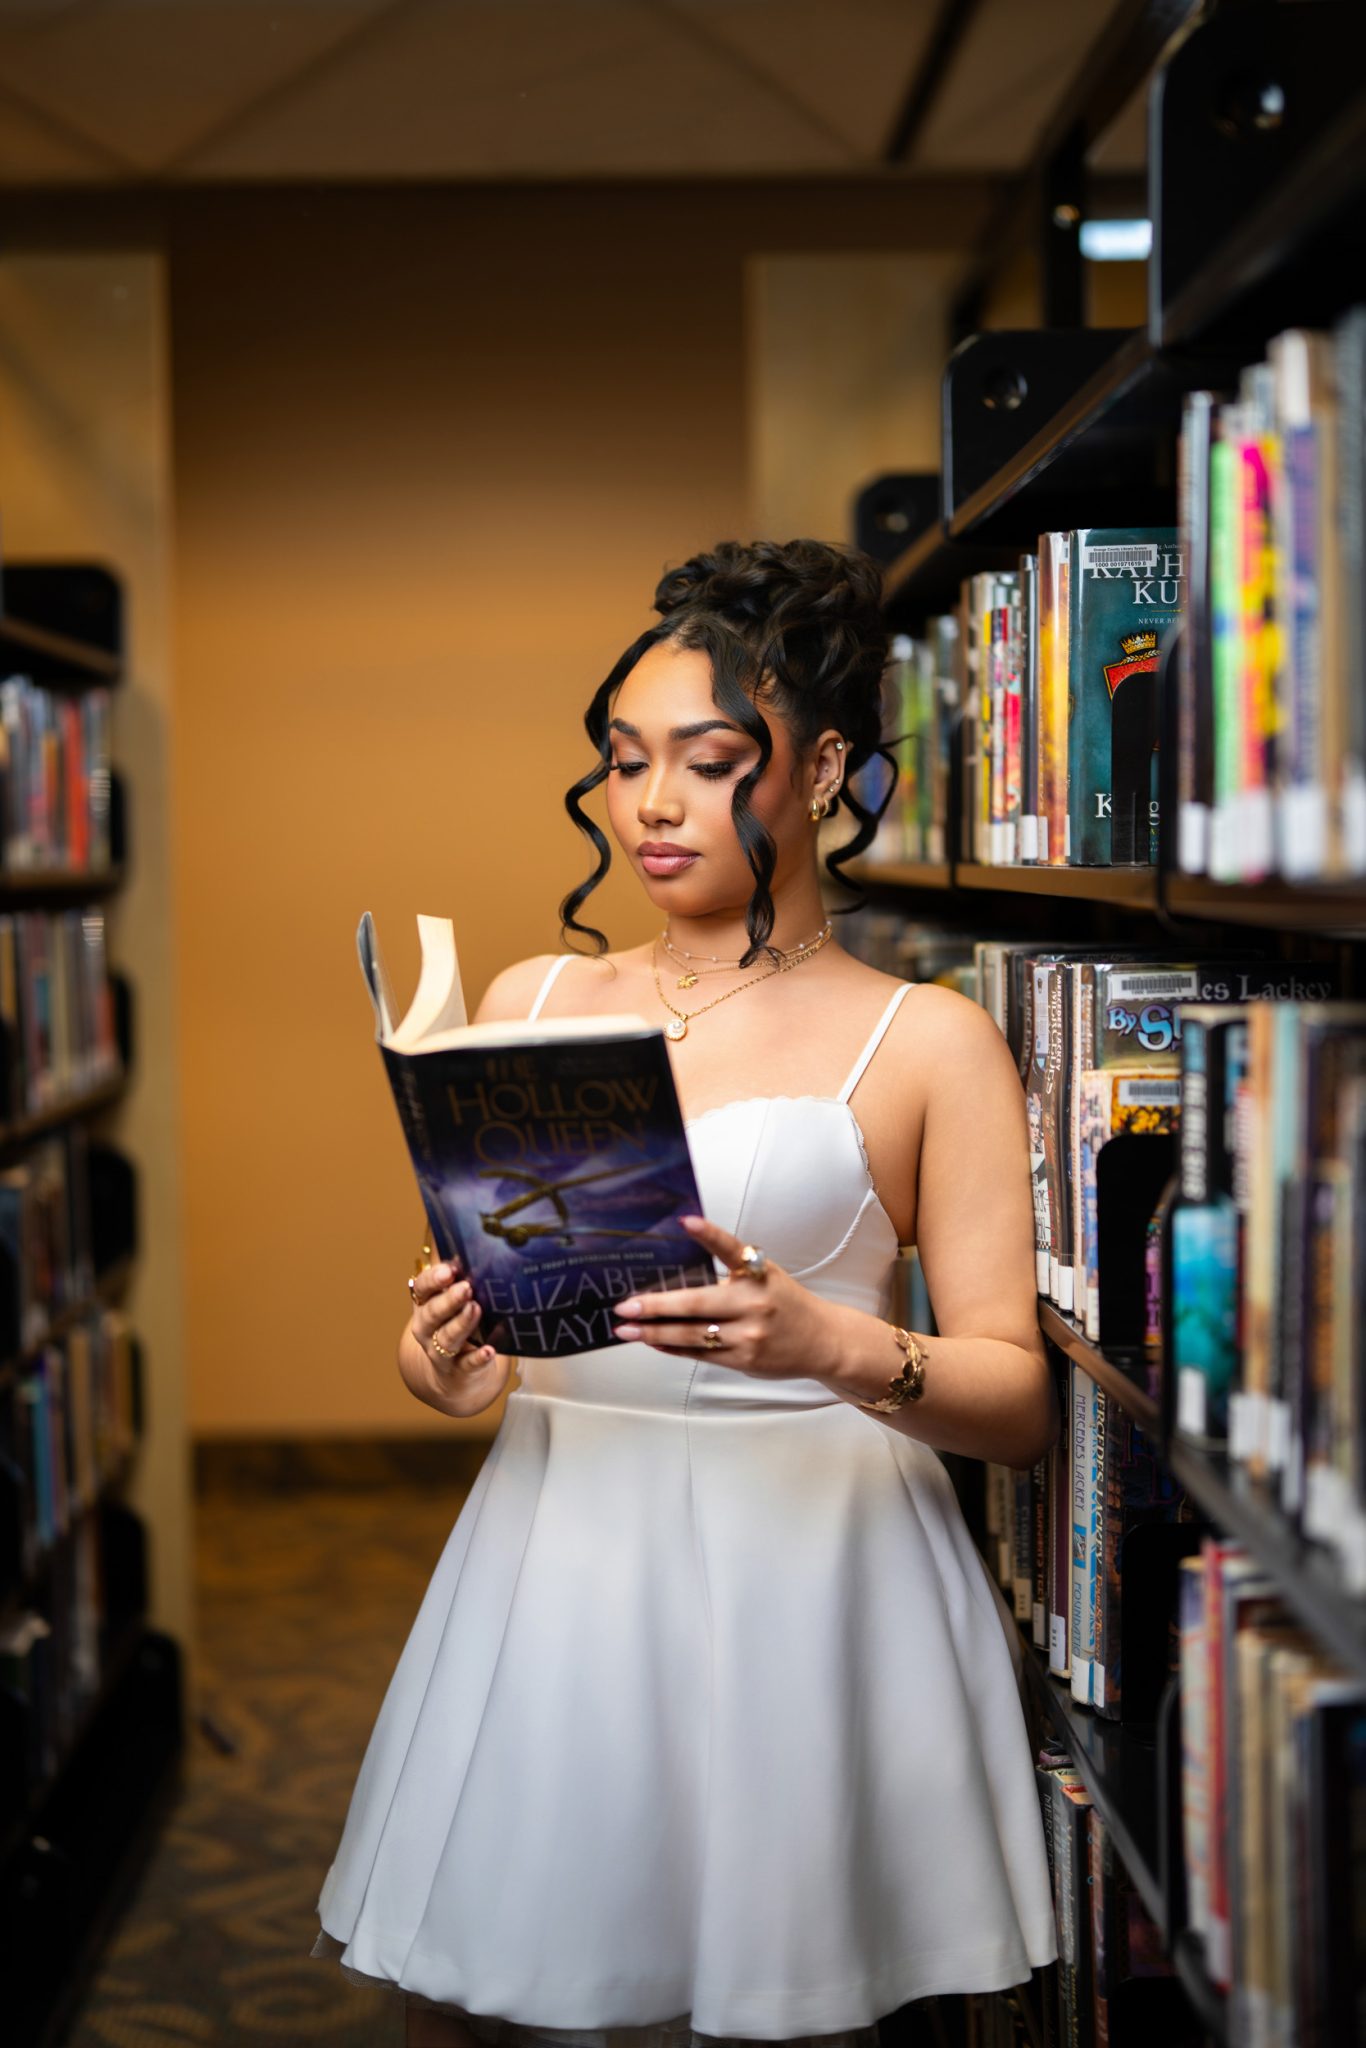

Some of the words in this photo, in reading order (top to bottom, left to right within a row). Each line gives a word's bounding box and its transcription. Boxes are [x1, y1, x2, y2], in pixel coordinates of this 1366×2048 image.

[1138, 617, 1165, 625] NEVER
[1236, 973, 1333, 1001] Lackey
[1107, 1006, 1138, 1036] By
[445, 1074, 660, 1127] HOLLOW
[473, 1116, 647, 1169] QUEEN
[482, 1262, 712, 1316] ELIZABETH
[1075, 1394, 1086, 1459] MERCEDES
[1075, 1464, 1085, 1511] LACKEY
